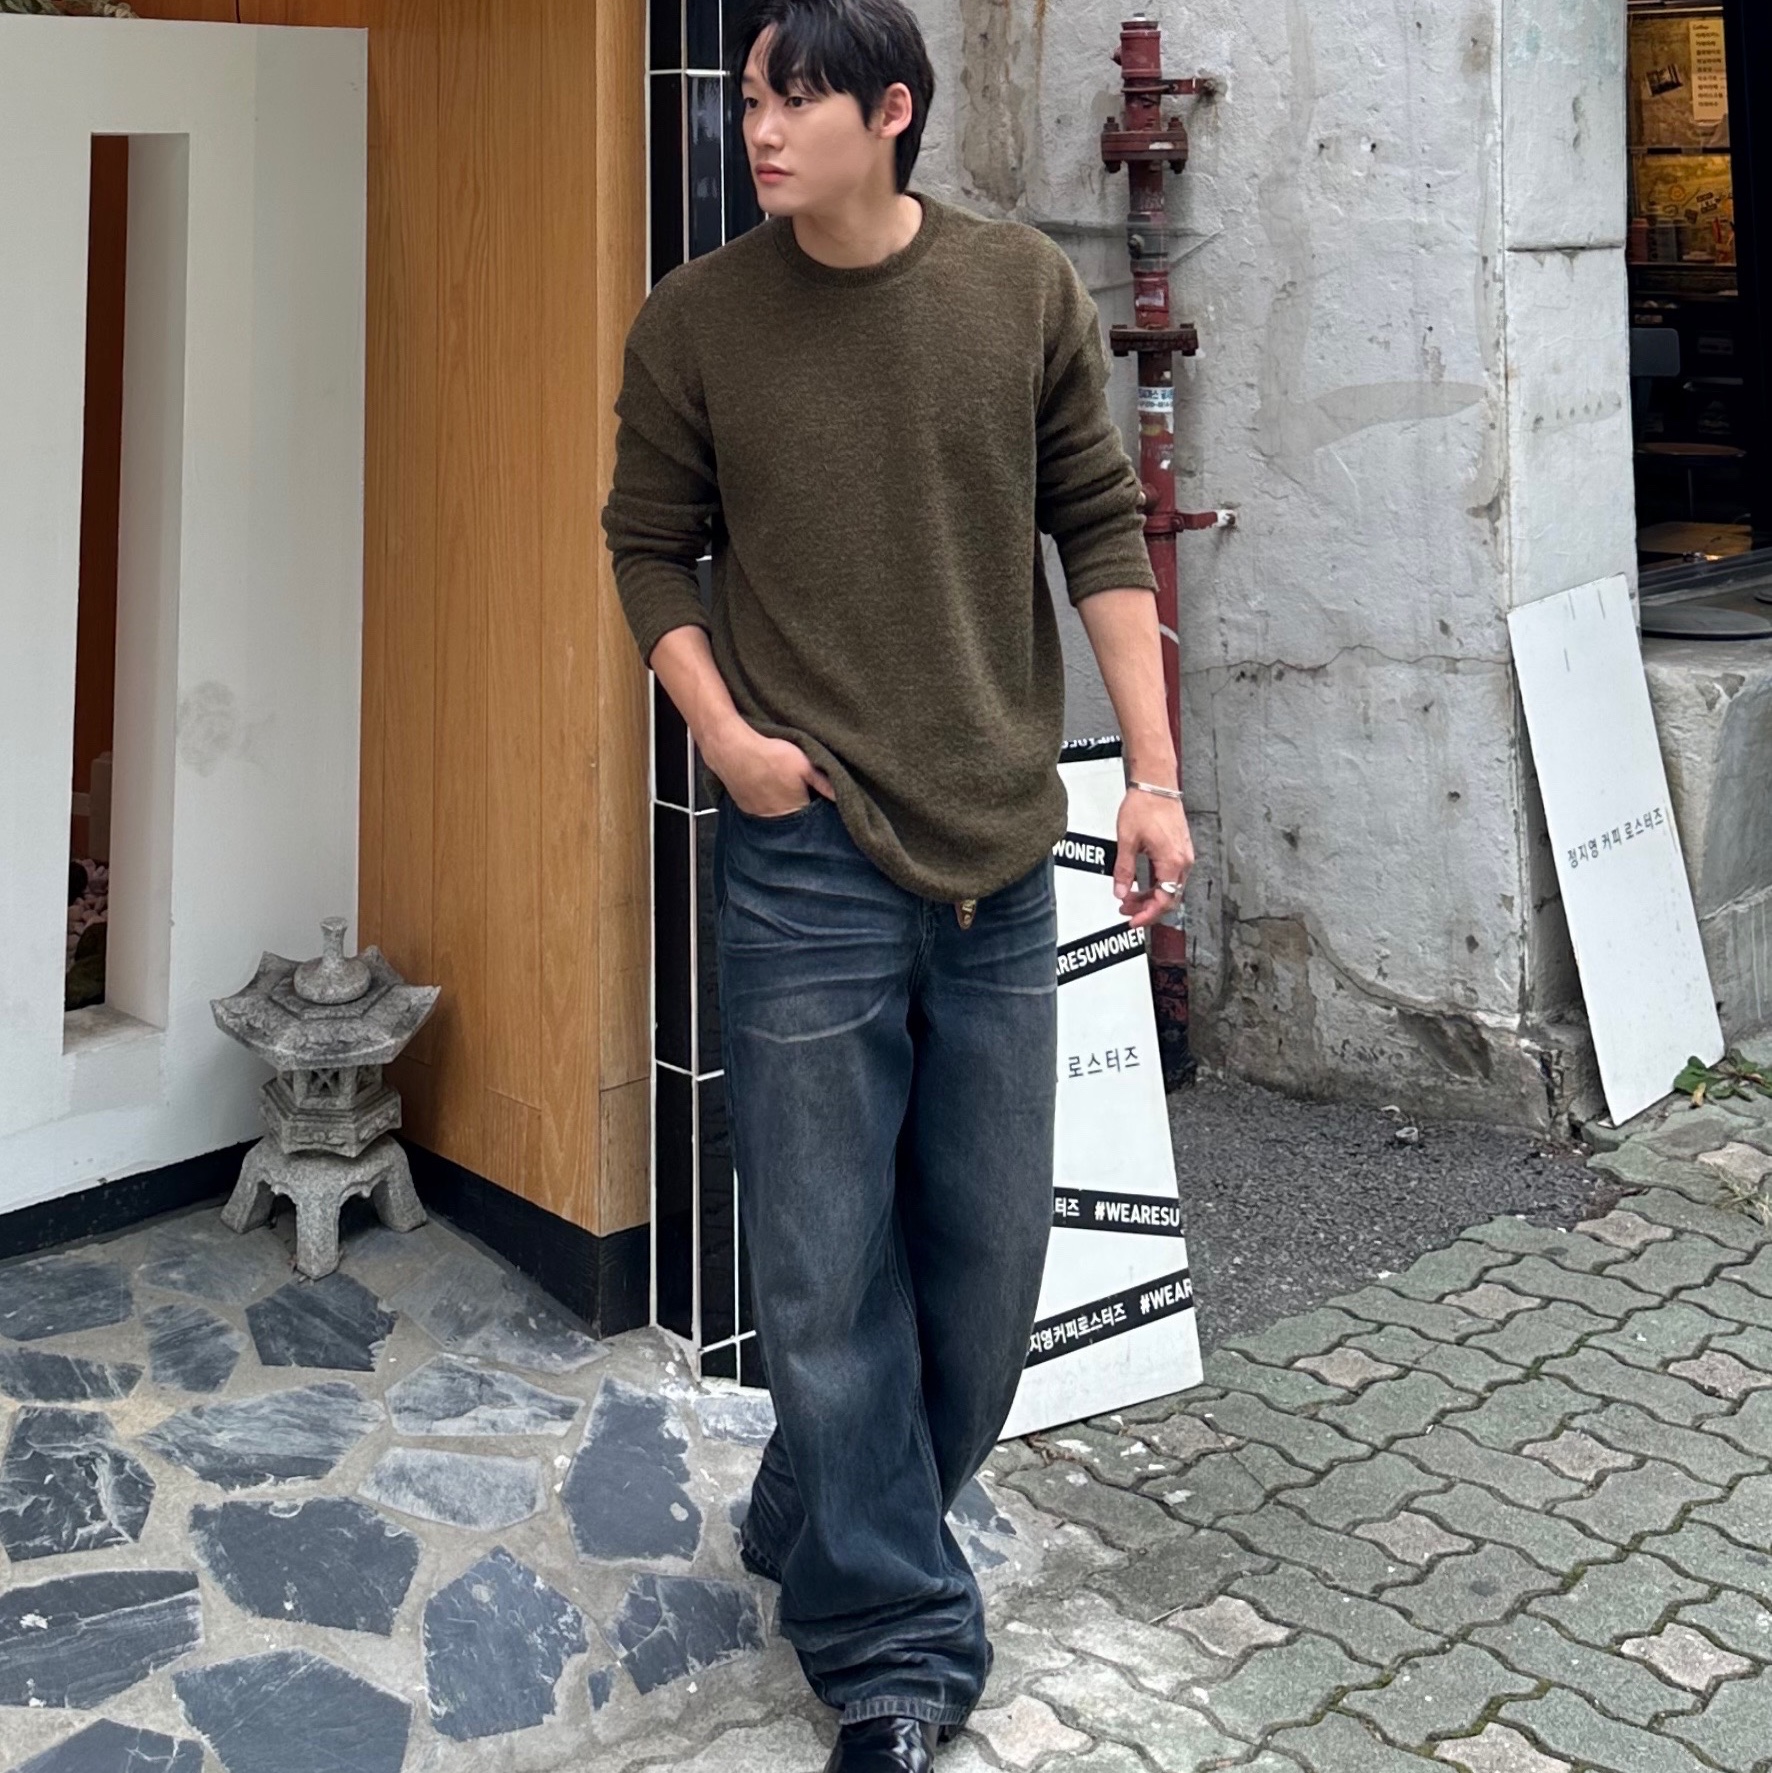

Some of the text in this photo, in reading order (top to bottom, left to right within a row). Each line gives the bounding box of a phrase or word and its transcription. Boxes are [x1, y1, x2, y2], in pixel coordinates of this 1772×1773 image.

[1567, 807, 1664, 869] 정지영 커피 로스터즈
[1068, 1046, 1140, 1079] 로스터즈
[1094, 1200, 1180, 1227] #WEARESU
[1140, 1277, 1193, 1315] #WEAR
